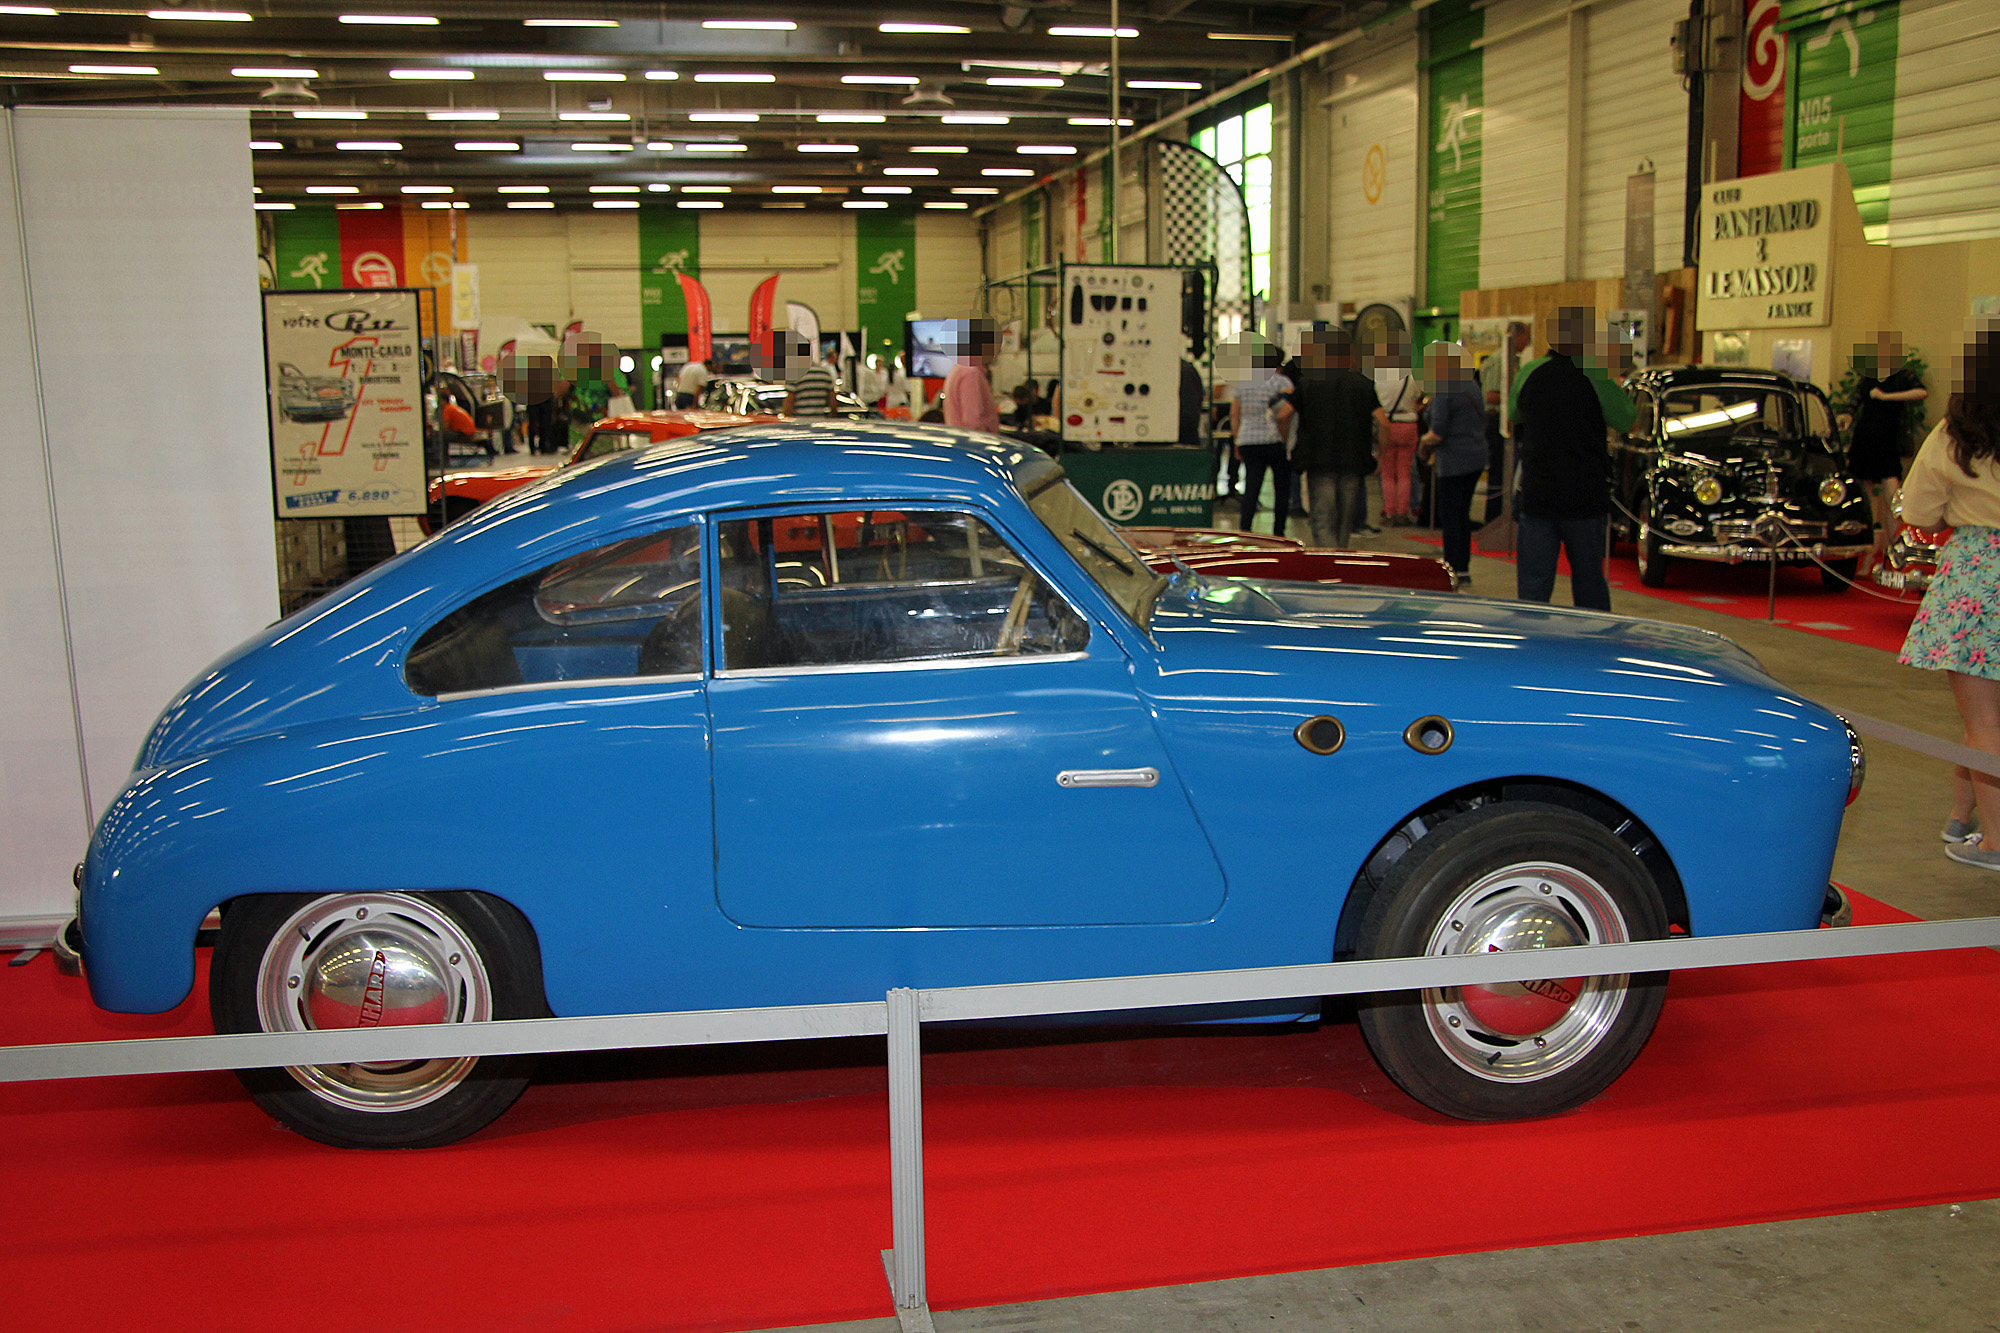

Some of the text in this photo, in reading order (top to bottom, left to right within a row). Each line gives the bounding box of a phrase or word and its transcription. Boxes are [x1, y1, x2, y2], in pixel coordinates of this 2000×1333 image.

[1710, 200, 1819, 240] PANHARD
[1705, 263, 1816, 299] LEVASSOR
[340, 345, 412, 359] MONTE-CARLO
